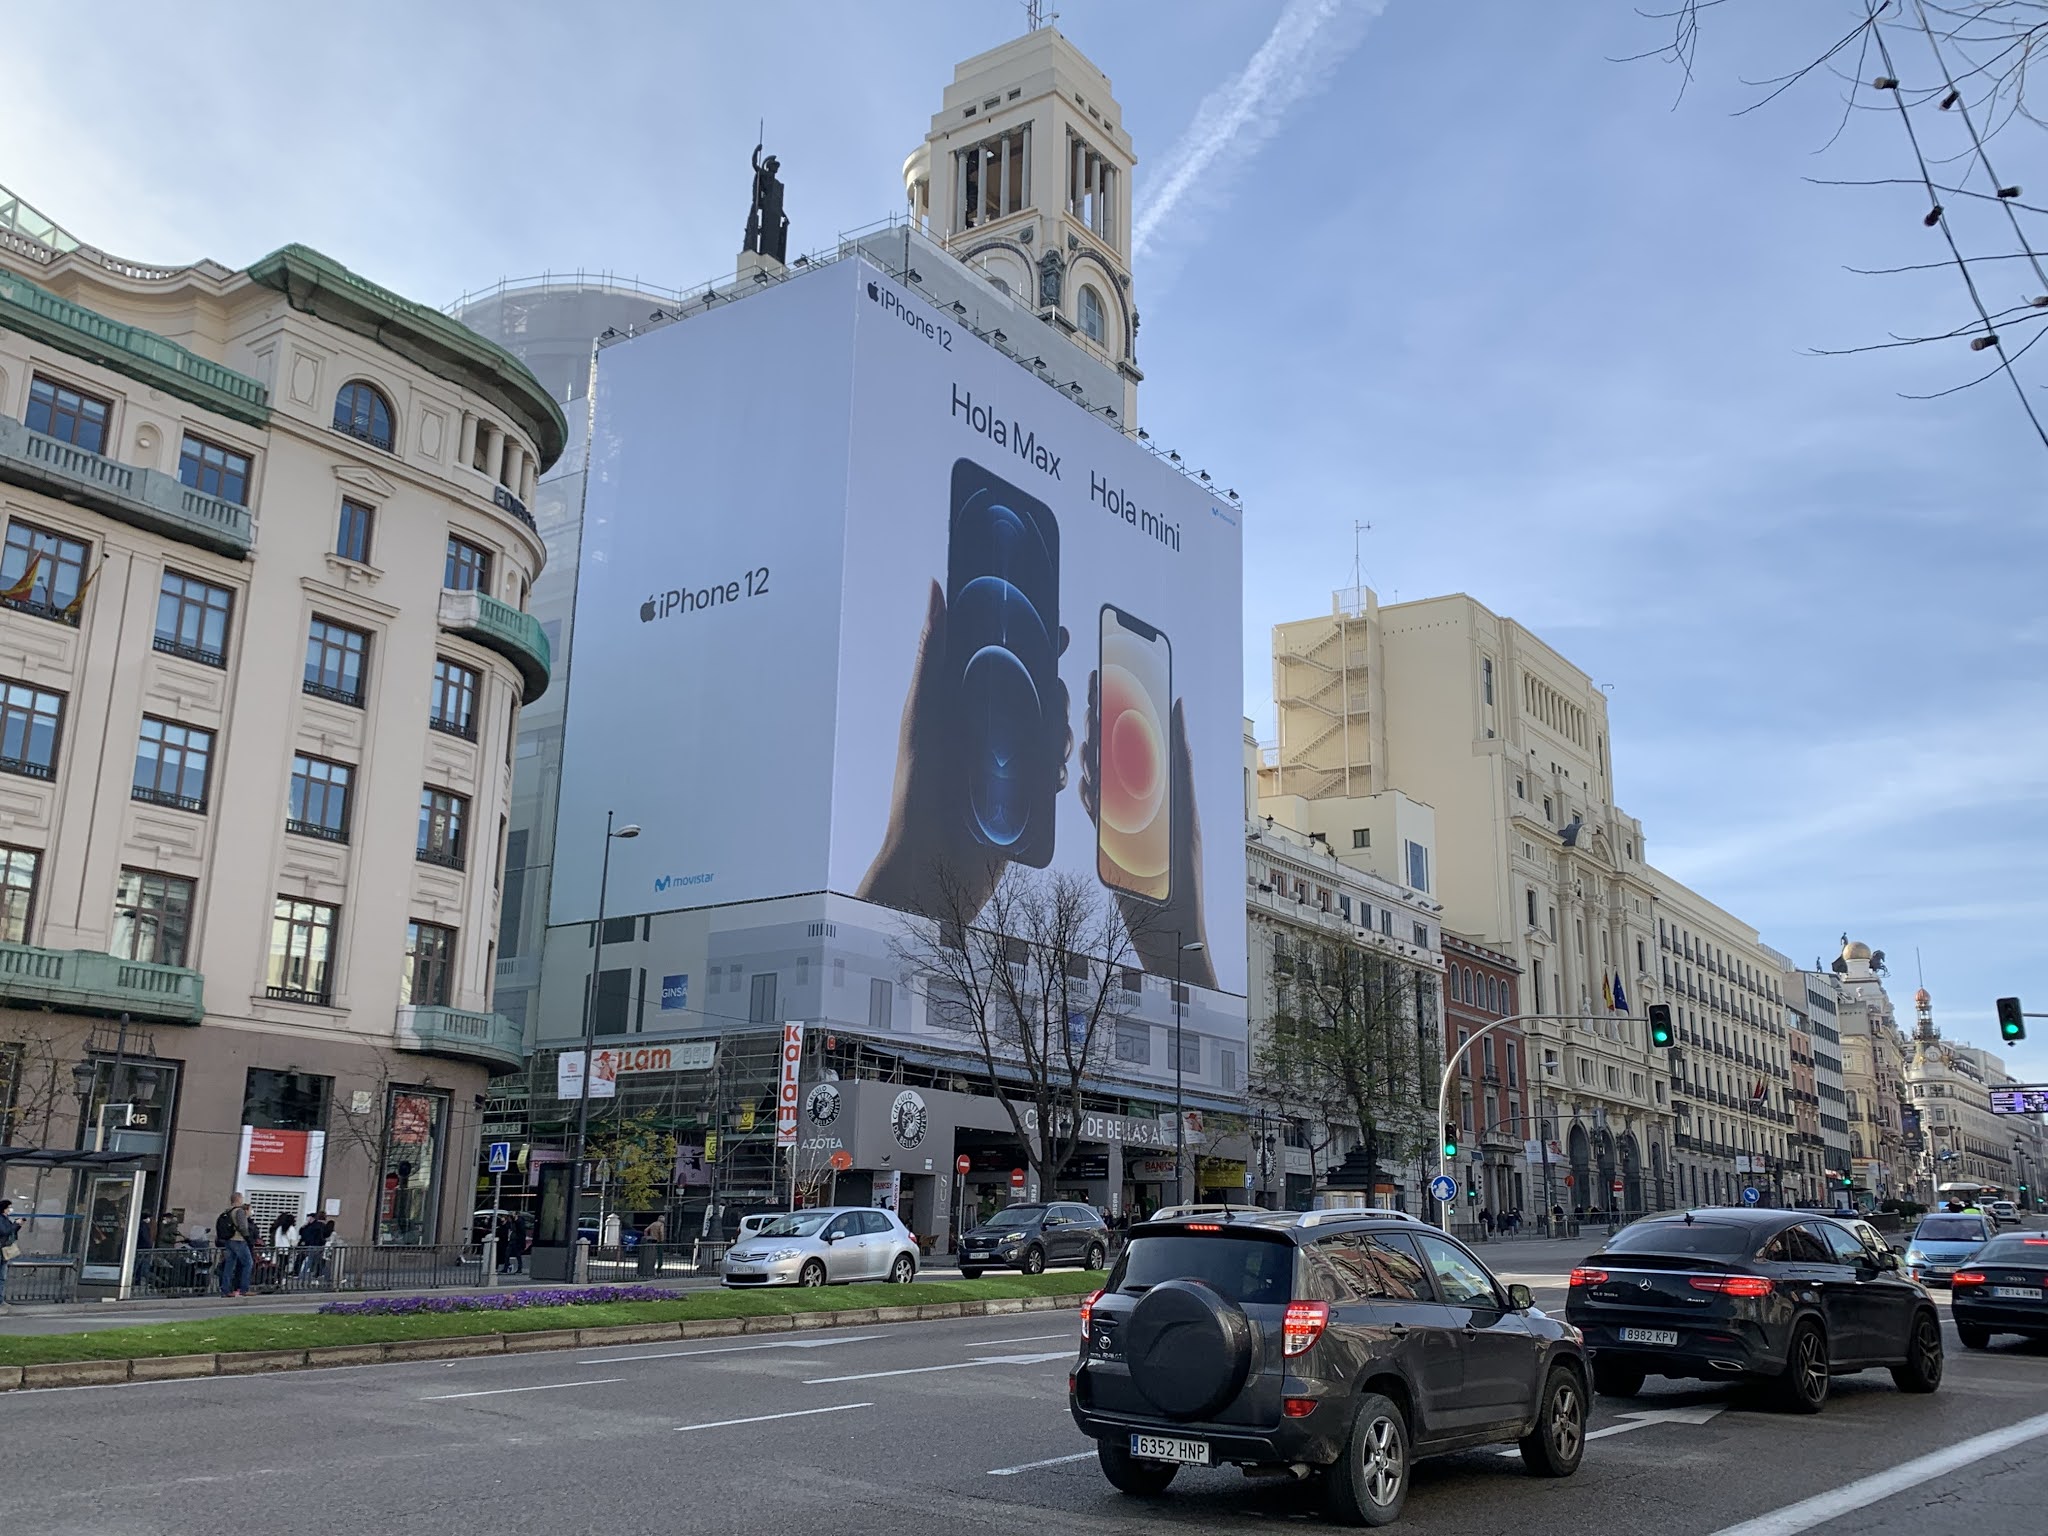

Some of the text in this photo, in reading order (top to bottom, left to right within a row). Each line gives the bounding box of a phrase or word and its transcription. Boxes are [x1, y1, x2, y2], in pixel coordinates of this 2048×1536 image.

[881, 286, 953, 352] iPhone 12
[951, 382, 1062, 481] Hola Max
[1090, 470, 1181, 552] Hola mini
[658, 567, 770, 619] iPhone 12
[673, 873, 715, 887] movistar
[662, 987, 687, 998] GINSA
[801, 1137, 843, 1149] AZOTEA
[1087, 1117, 1104, 1137] DE
[1107, 1120, 1148, 1144] BELLAS
[1627, 1329, 1676, 1343] 8982 KPV
[1140, 1437, 1205, 1460] 6352 HNP
